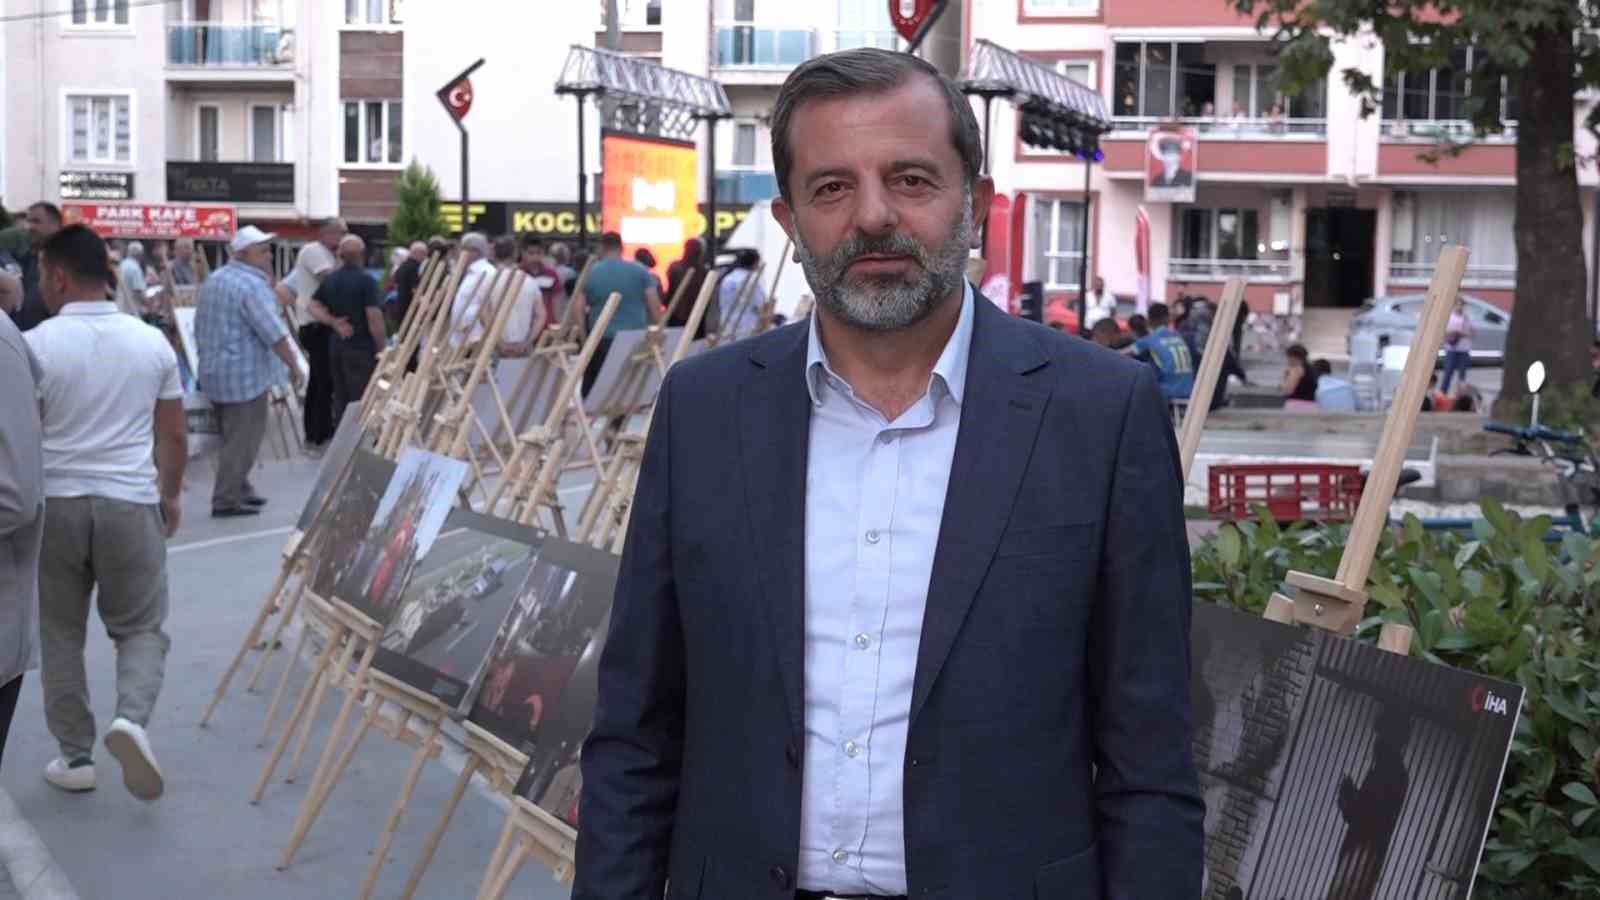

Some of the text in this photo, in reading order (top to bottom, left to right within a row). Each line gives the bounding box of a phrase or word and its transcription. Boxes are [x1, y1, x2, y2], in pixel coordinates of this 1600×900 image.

[97, 207, 197, 222] PARK KAFE
[1484, 690, 1507, 715] İHA
